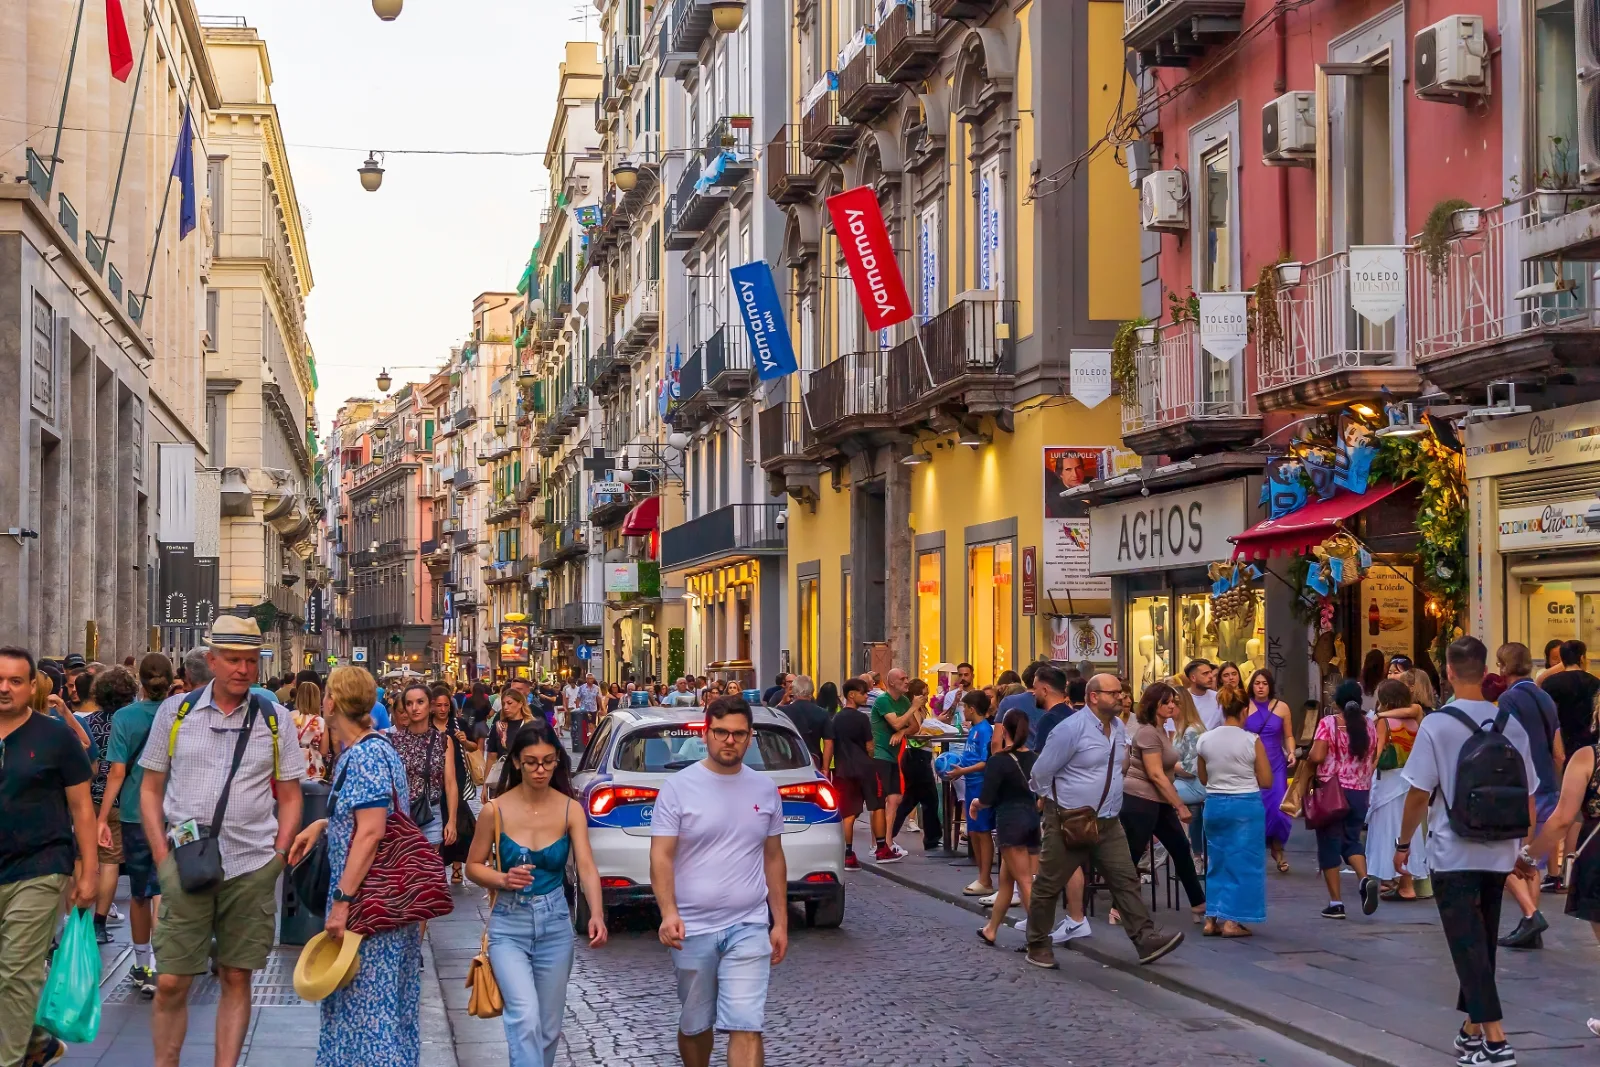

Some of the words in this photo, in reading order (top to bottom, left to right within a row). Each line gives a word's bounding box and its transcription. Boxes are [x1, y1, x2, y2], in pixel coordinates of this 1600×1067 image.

[845, 208, 896, 318] yamamay
[1355, 271, 1399, 282] TOLEDO
[738, 280, 778, 372] yamamay
[762, 310, 777, 333] MAN
[1205, 315, 1243, 324] TOLEDO
[1074, 368, 1107, 376] TOLEDO
[1117, 501, 1203, 562] AGHOS
[663, 729, 699, 737] Polizia
